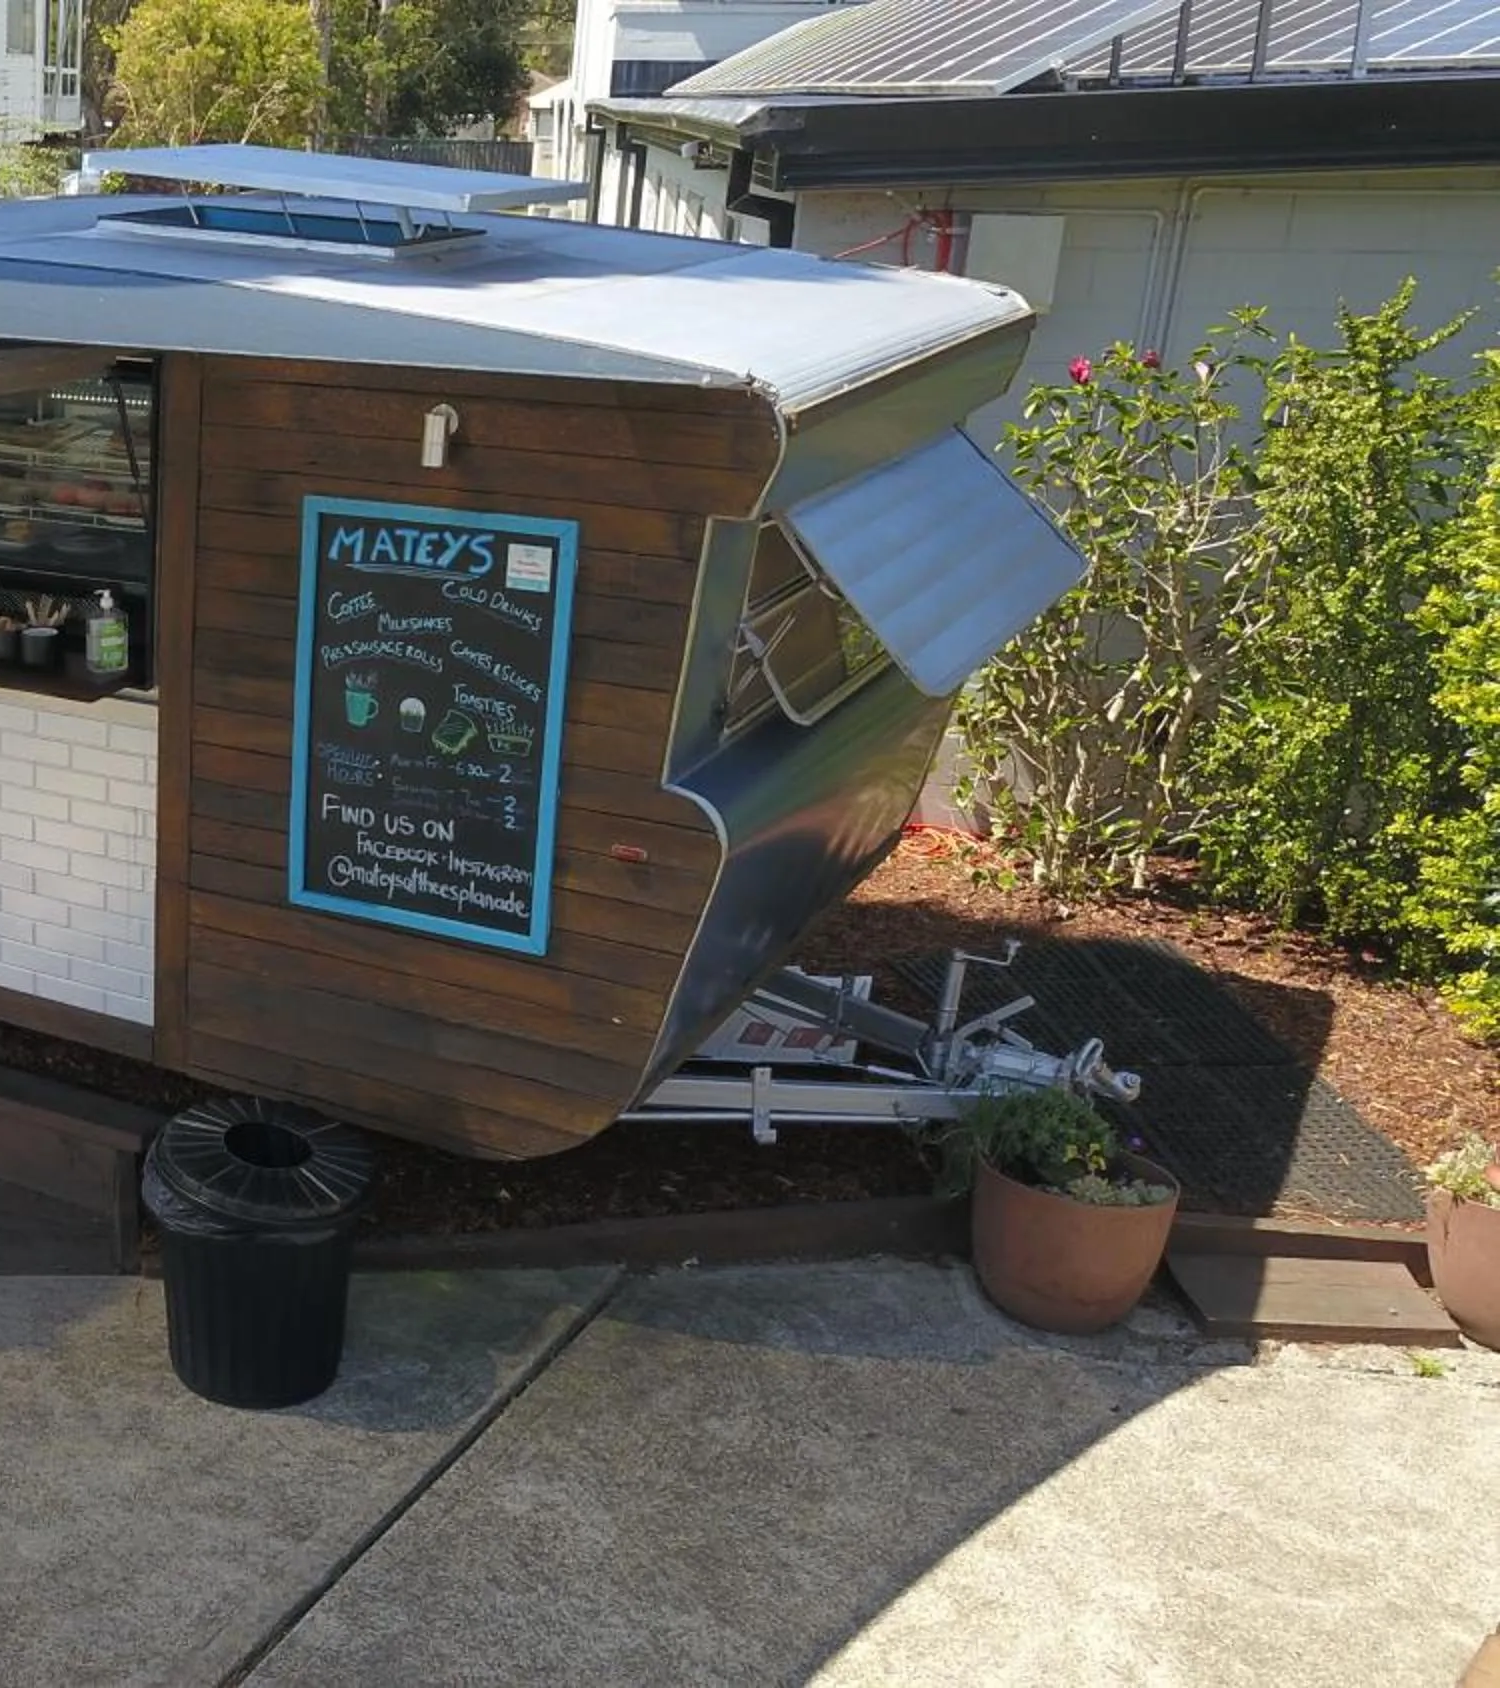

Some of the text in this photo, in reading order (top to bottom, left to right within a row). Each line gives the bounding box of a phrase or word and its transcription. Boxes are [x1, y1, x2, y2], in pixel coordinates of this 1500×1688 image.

[327, 526, 495, 574] MATEYS
[327, 591, 376, 619] COFFEE
[442, 581, 543, 632] COLD DRINKS
[452, 683, 517, 724] TOASTIES
[322, 793, 375, 828] FIND
[384, 813, 415, 835] US
[423, 819, 455, 842] ON
[357, 831, 533, 887] FACEBOOK INSTAGRAM
